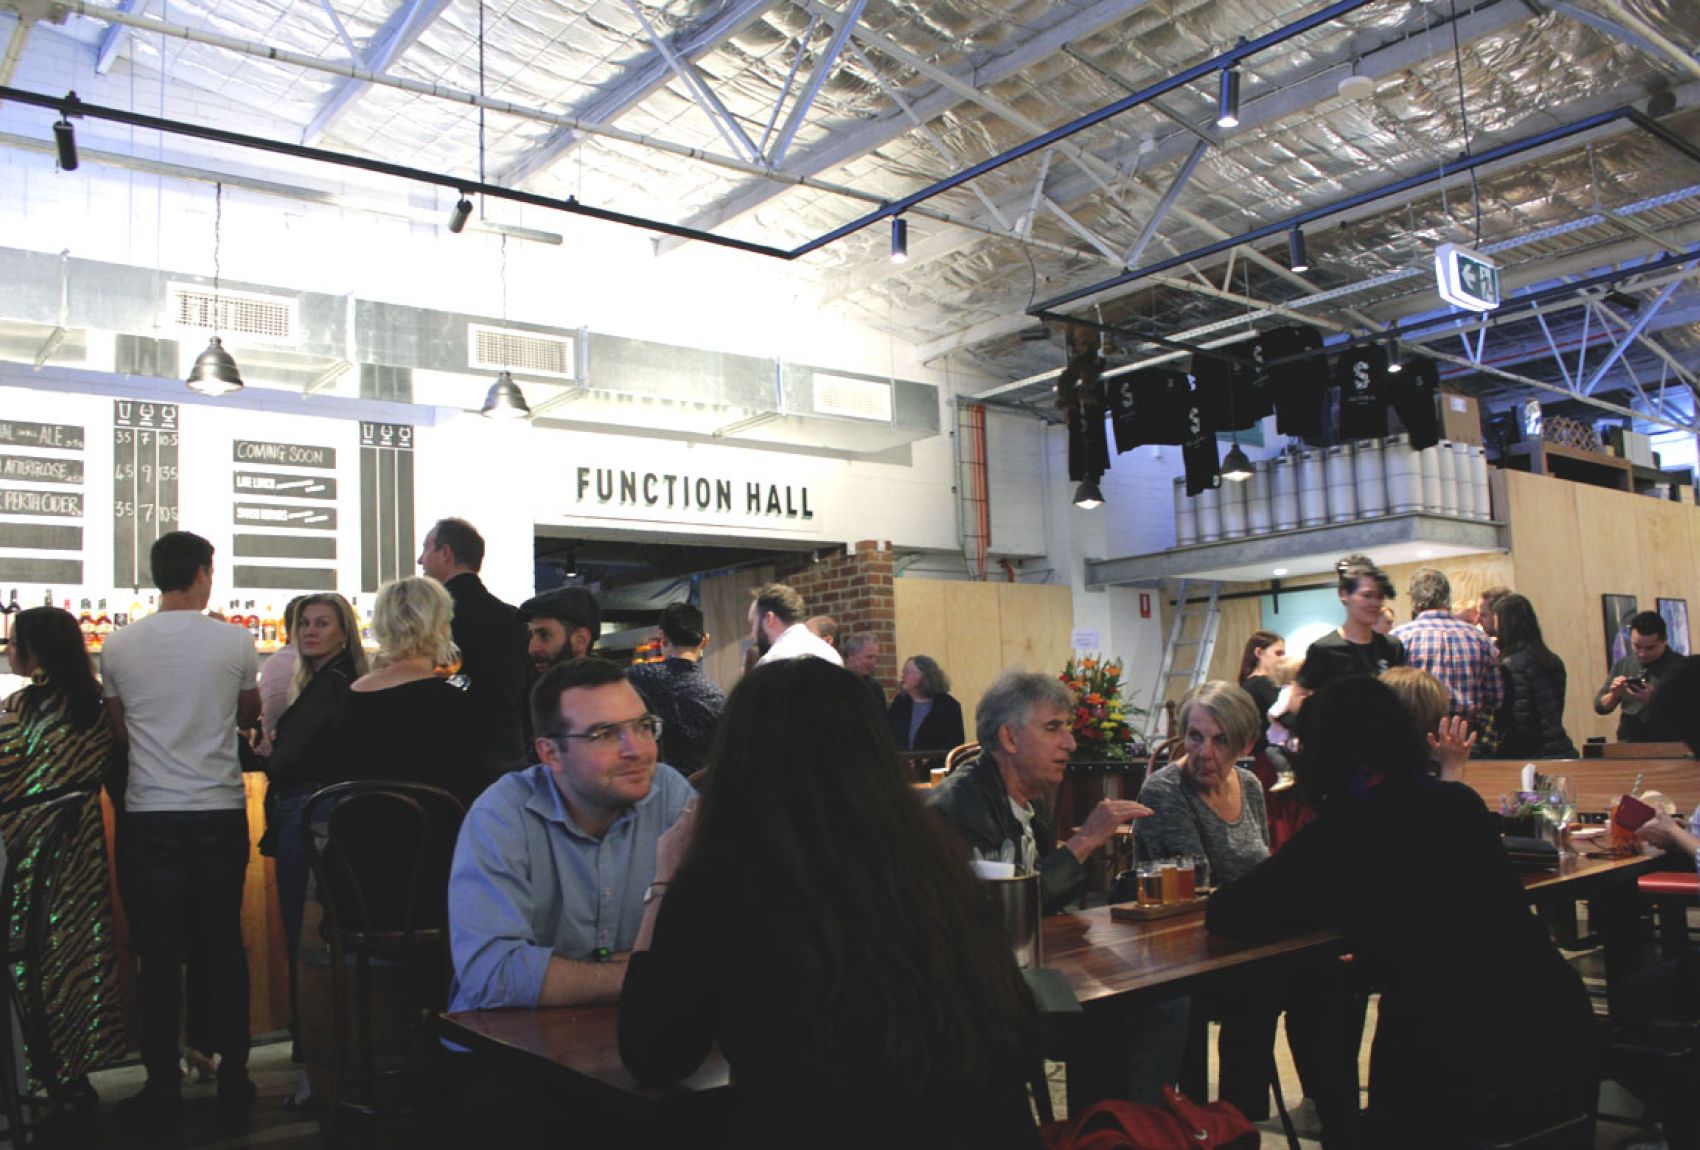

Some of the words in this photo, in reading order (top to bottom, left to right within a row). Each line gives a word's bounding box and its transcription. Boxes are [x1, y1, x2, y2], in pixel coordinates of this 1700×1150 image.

[40, 426, 64, 446] ALE
[237, 442, 286, 462] COMING
[289, 446, 324, 464] SOON
[142, 465, 152, 483] 9
[5, 491, 40, 511] PERTH
[41, 493, 79, 514] CIDER
[577, 466, 732, 511] FUNCTION
[746, 482, 814, 519] HALL
[139, 503, 154, 522] 7
